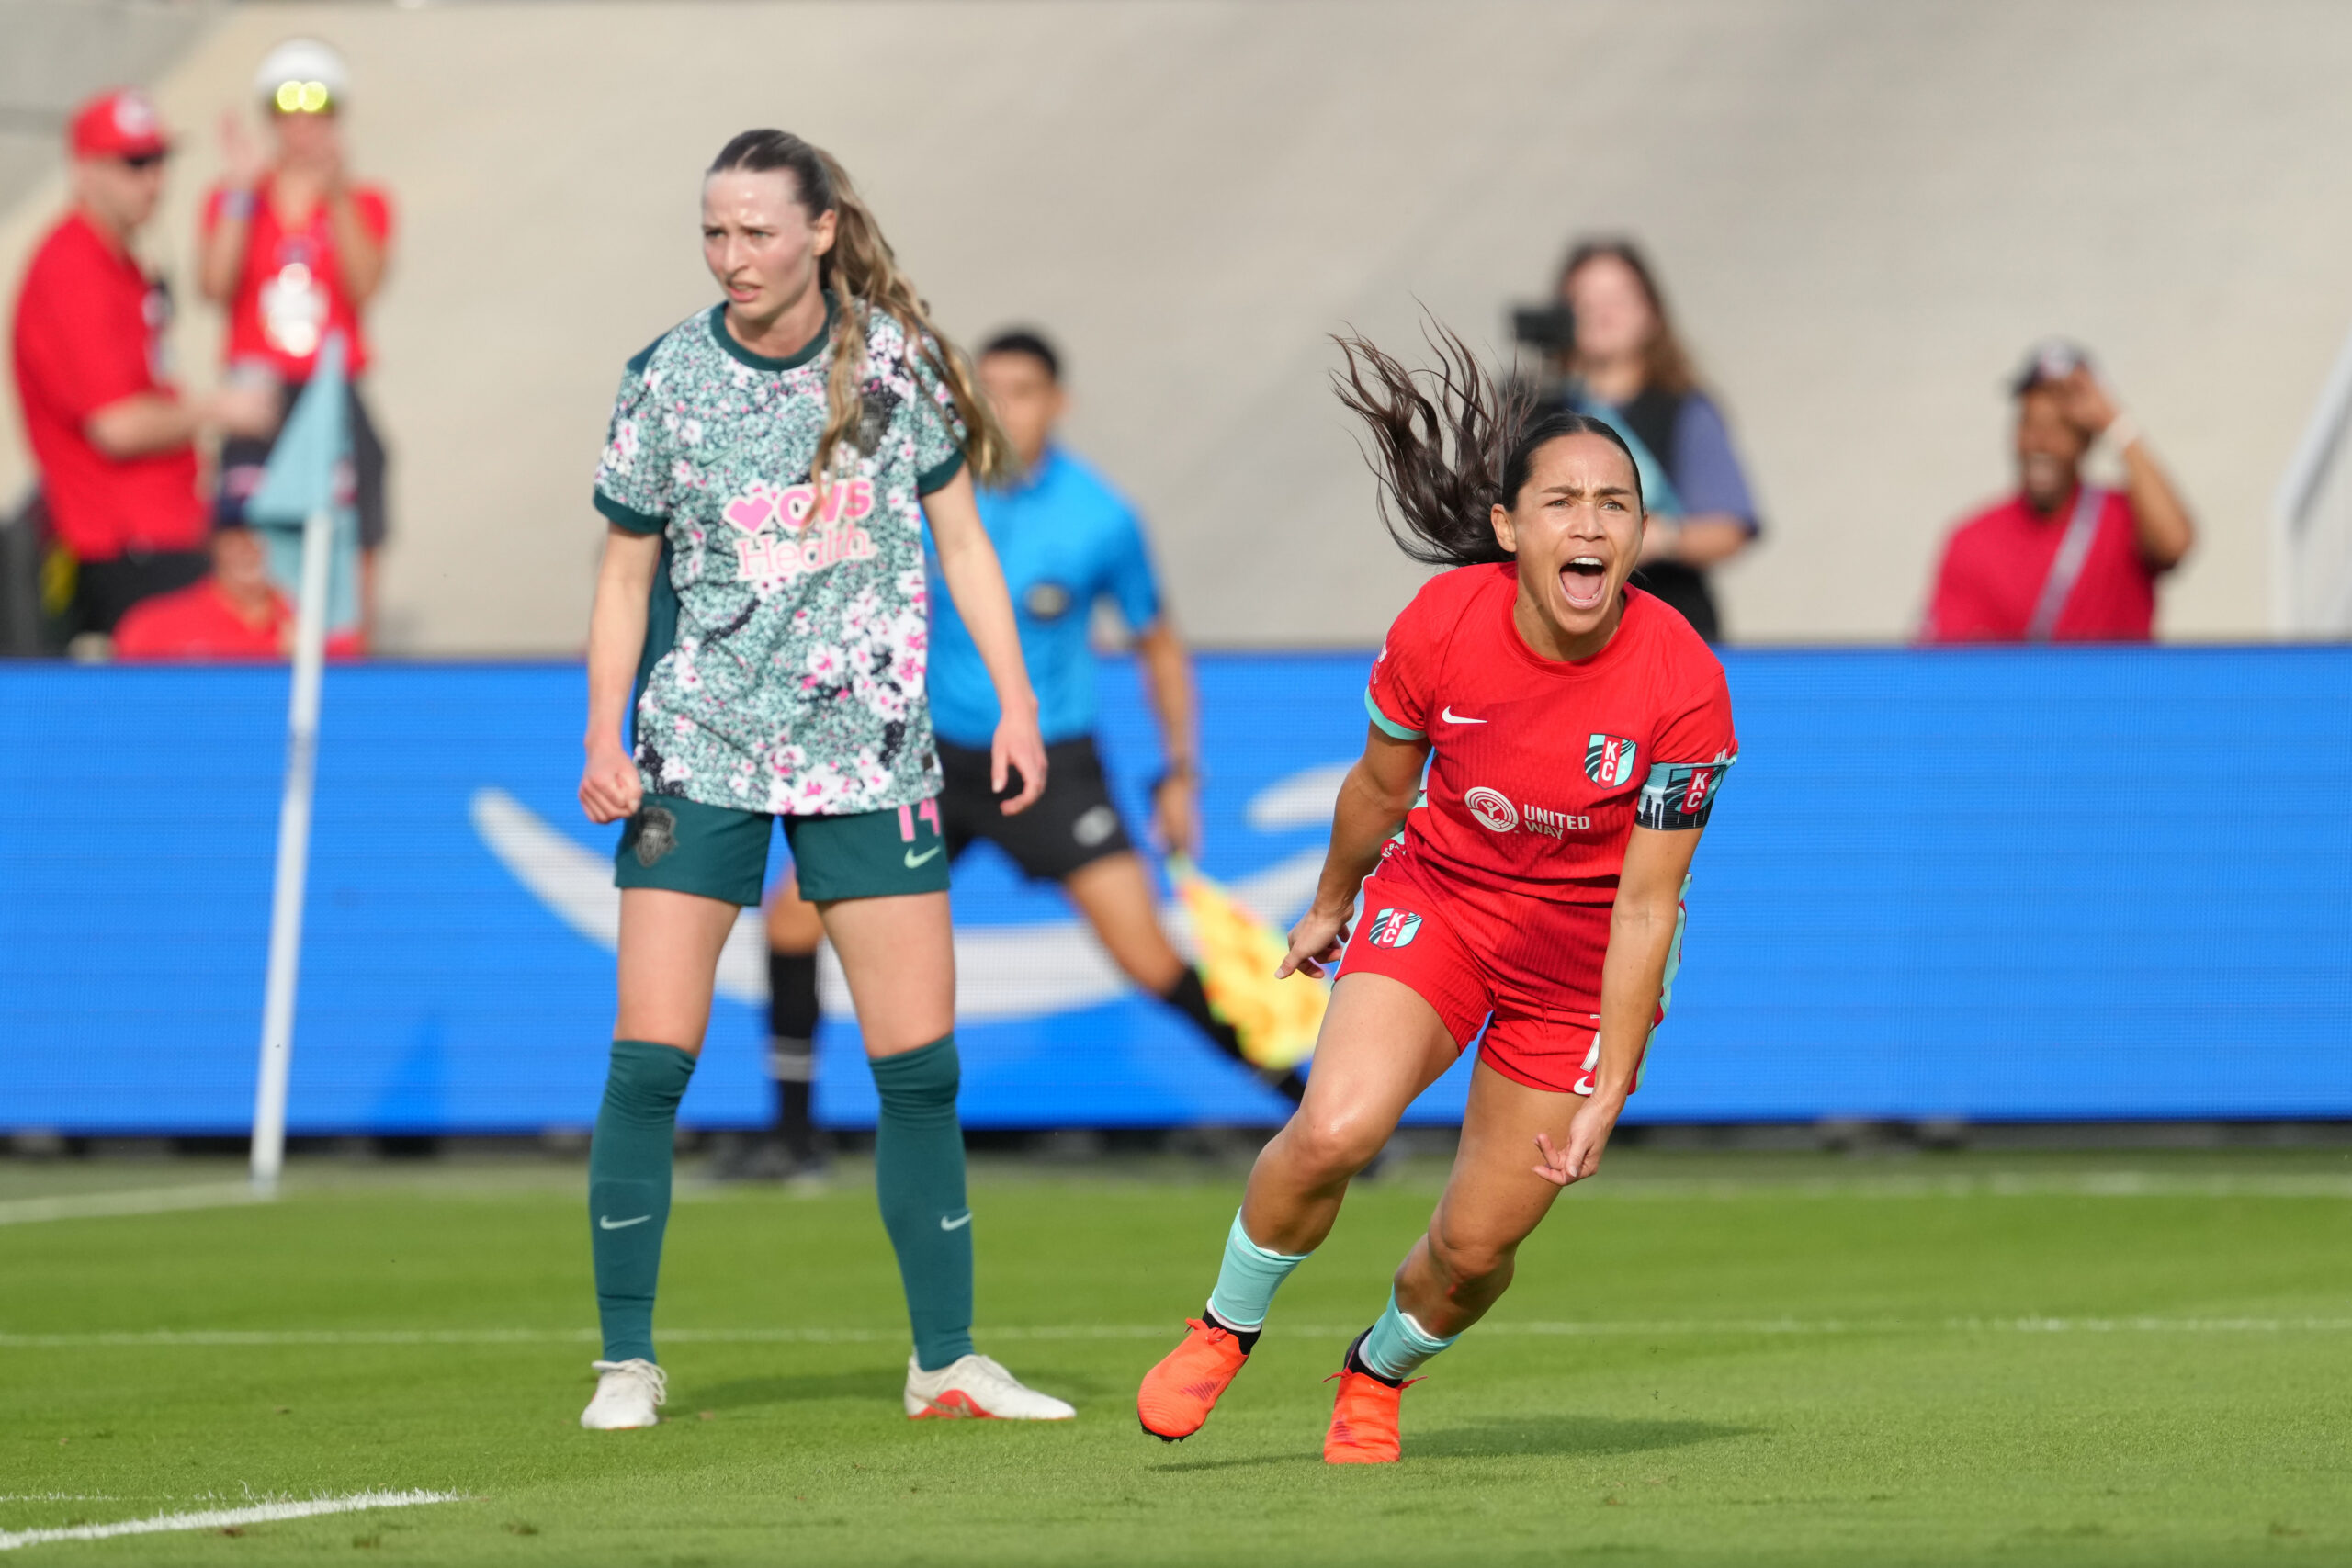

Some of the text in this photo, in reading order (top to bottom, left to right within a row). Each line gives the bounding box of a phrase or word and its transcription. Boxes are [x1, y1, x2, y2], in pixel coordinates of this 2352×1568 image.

[778, 479, 873, 528] CVS
[737, 523, 869, 576] Health
[898, 796, 941, 842] 14
[1523, 804, 1590, 829] UNITED
[1524, 820, 1564, 840] WAY
